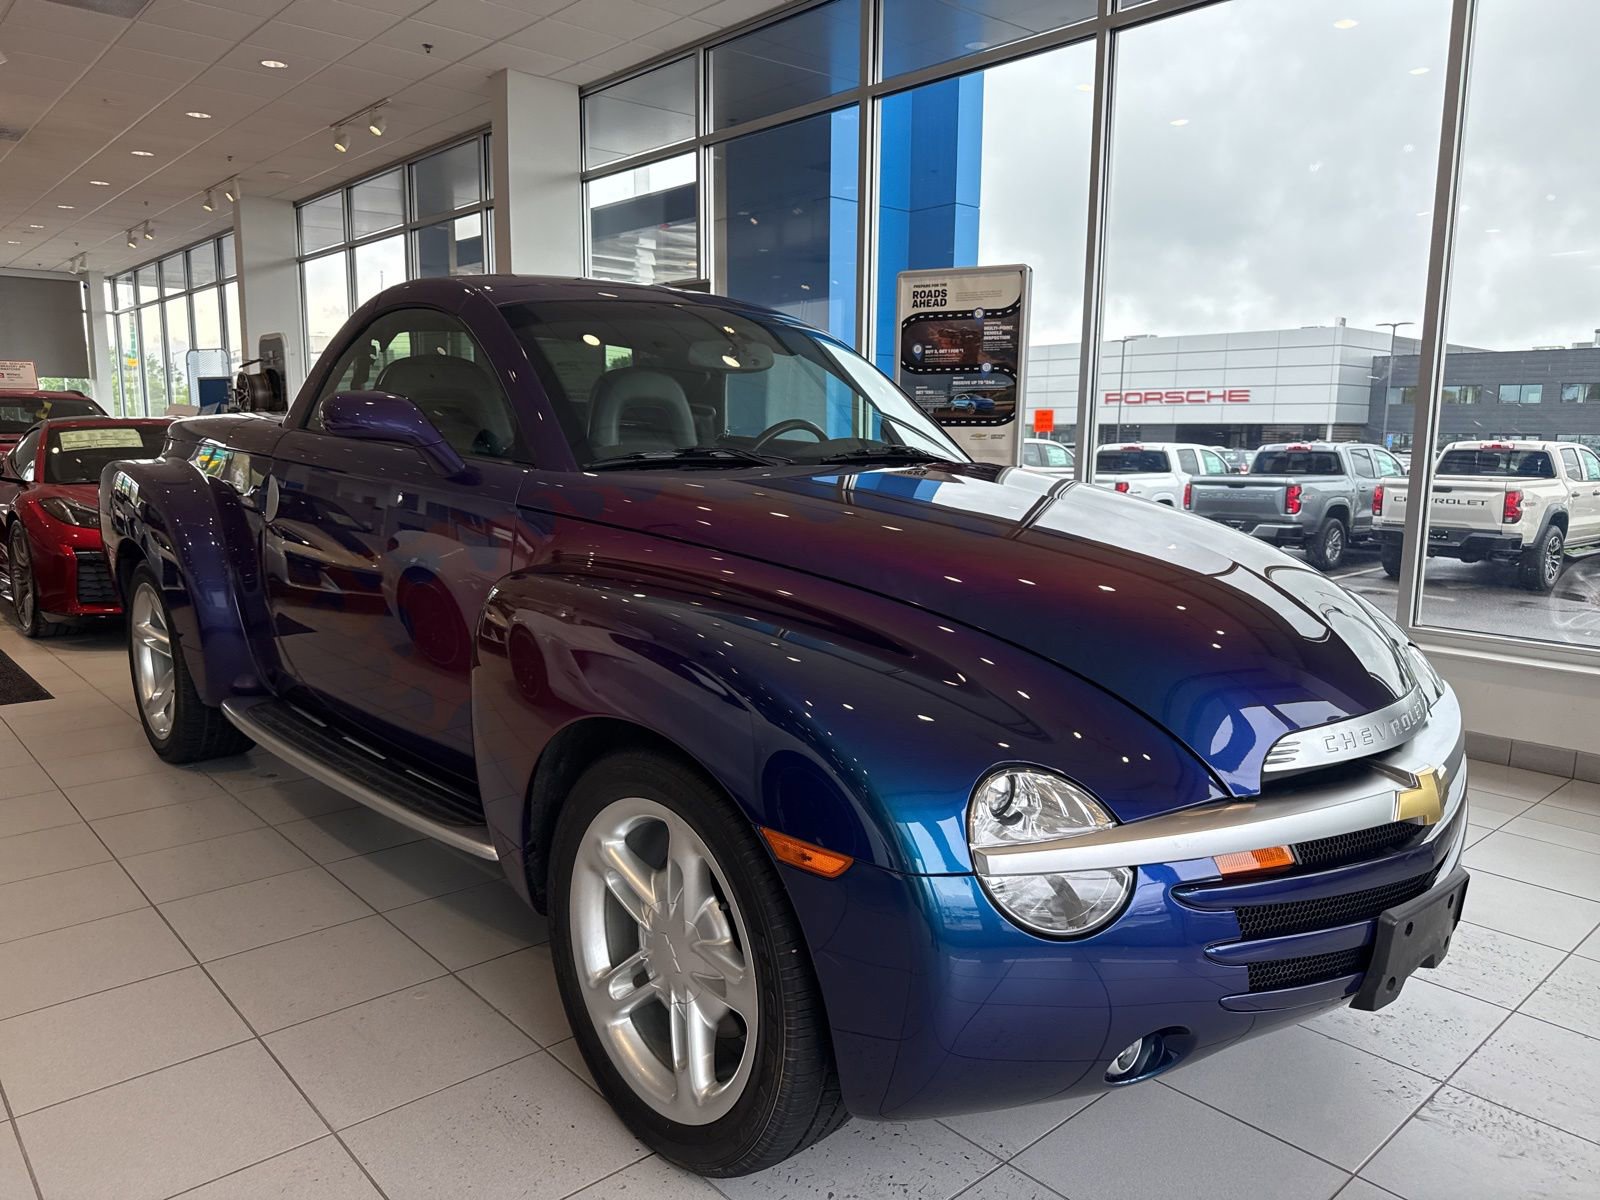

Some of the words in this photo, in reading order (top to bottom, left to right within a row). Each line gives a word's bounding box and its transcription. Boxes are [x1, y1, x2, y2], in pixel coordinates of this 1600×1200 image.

[912, 289, 948, 299] ROADS
[912, 298, 947, 308] AHEAD
[1105, 390, 1251, 405] PORSCHE
[1393, 496, 1489, 506] CROLET
[1322, 699, 1425, 753] CHEVROLET
